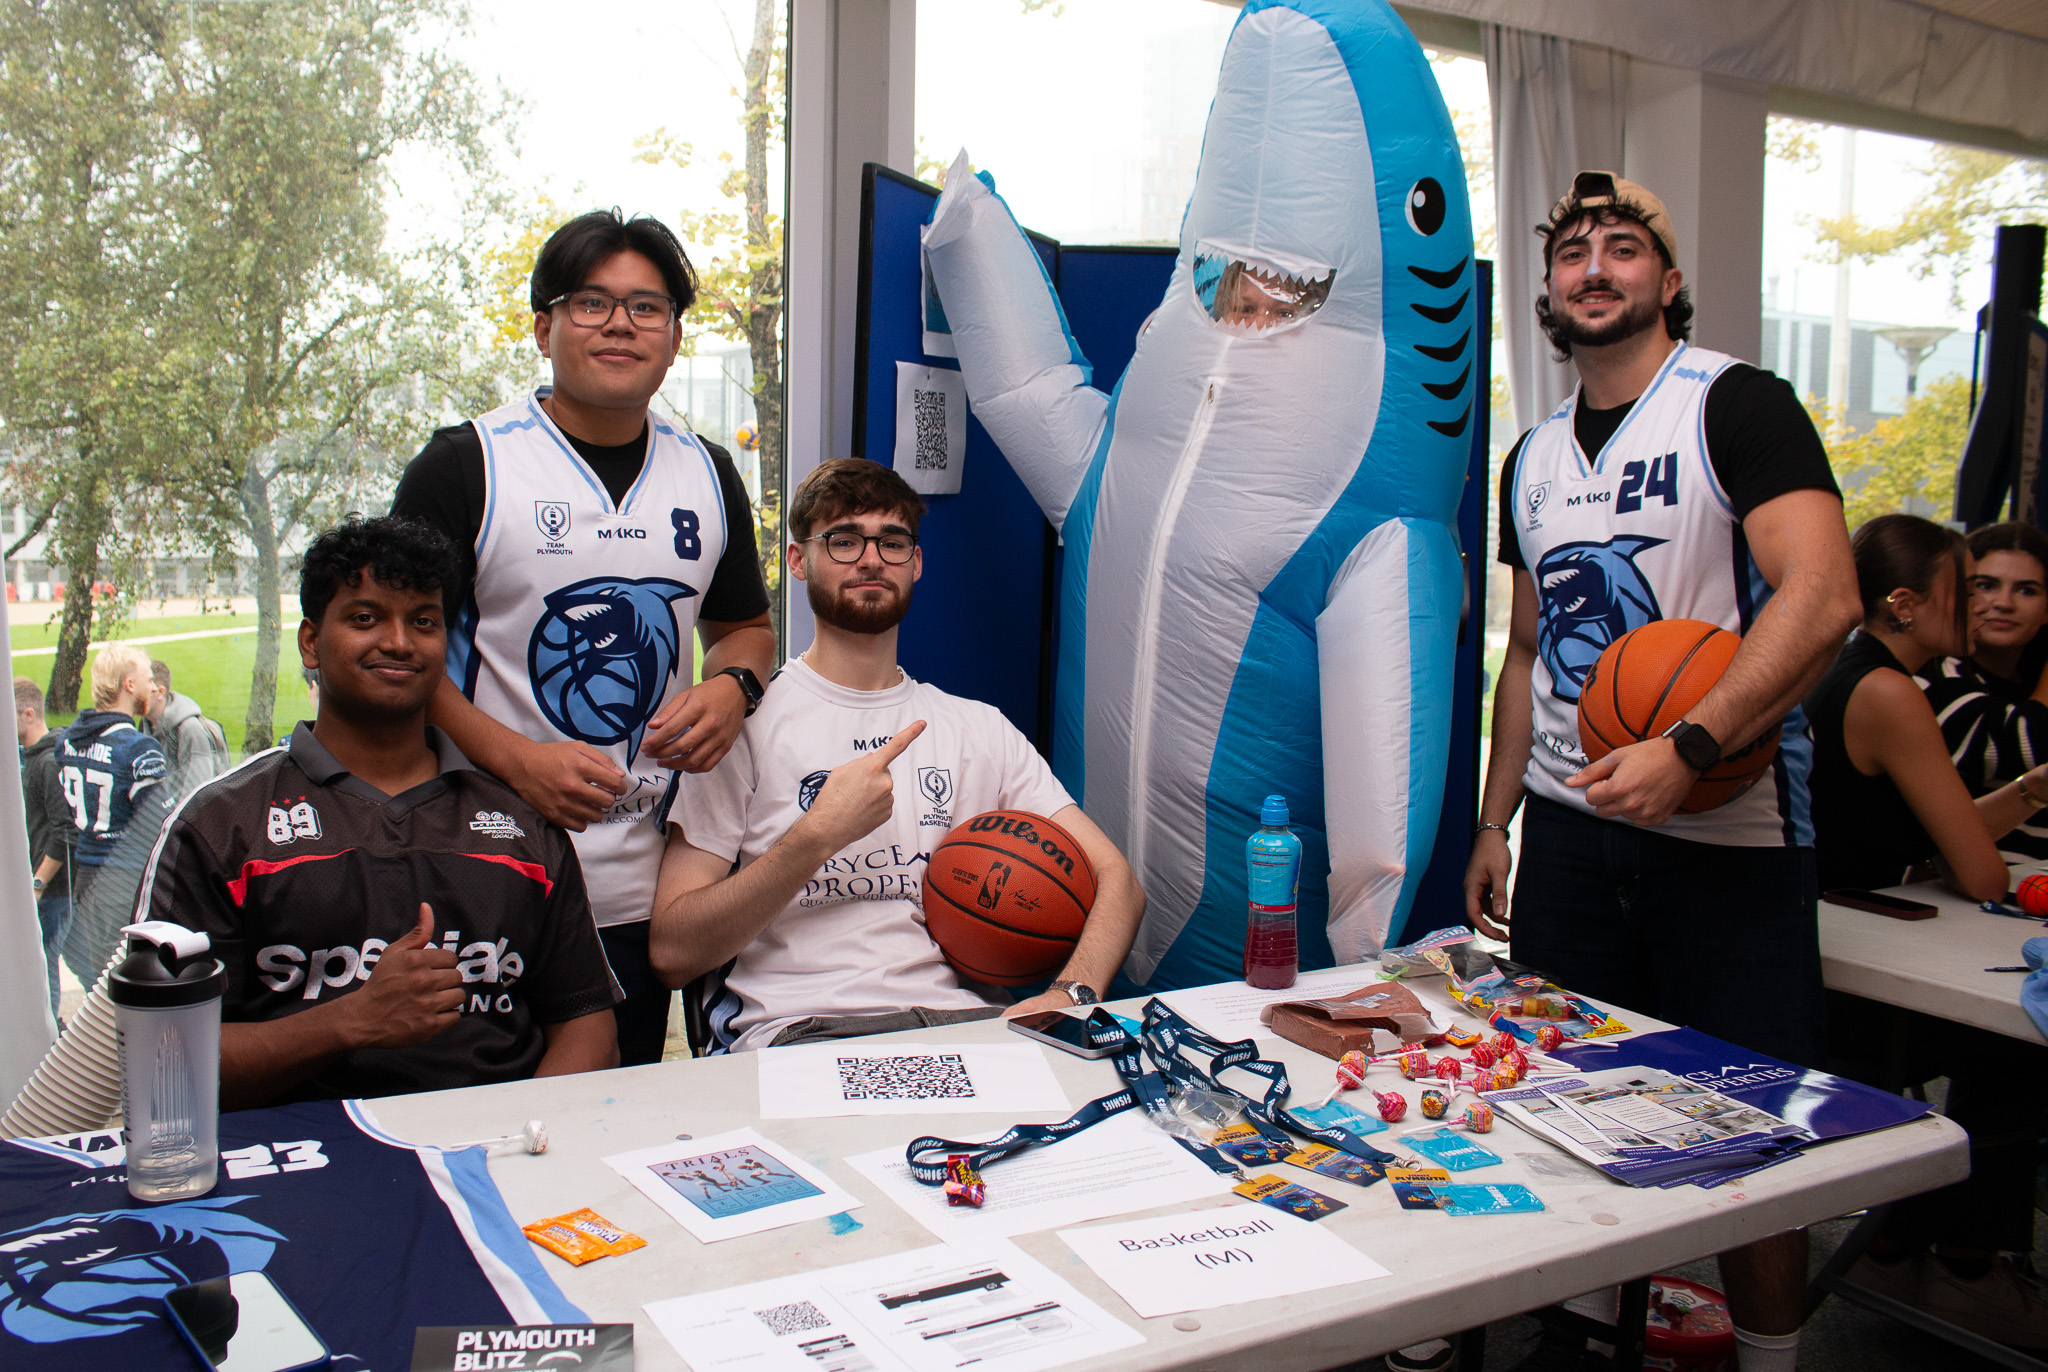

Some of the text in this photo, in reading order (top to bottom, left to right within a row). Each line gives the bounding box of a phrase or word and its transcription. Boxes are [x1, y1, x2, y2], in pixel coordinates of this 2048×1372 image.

[1616, 451, 1678, 515] 24
[1567, 491, 1611, 507] MAKO
[597, 527, 647, 540] MAKO
[670, 507, 702, 562] 8
[58, 766, 114, 832] 97
[267, 802, 322, 846] 89
[968, 815, 1075, 878] Wilson
[824, 844, 906, 874] RYCE
[1091, 1030, 1126, 1043] FISHIES
[1223, 1051, 1252, 1067] FISHIES
[1245, 1062, 1275, 1074] FISHIES
[1699, 1067, 1796, 1091] OPERTIES
[1102, 1093, 1133, 1112] FISHIES
[911, 1140, 944, 1155] FISHIES
[220, 1139, 331, 1180] 23
[666, 1149, 750, 1171] TRIALS
[71, 1173, 129, 1188] MAK
[911, 1166, 949, 1181] FISHIES
[1119, 1220, 1275, 1252] Basketball
[1194, 1248, 1254, 1270] (M)
[456, 1328, 596, 1352] PLYMOUTH
[453, 1350, 527, 1372] BLITZ
